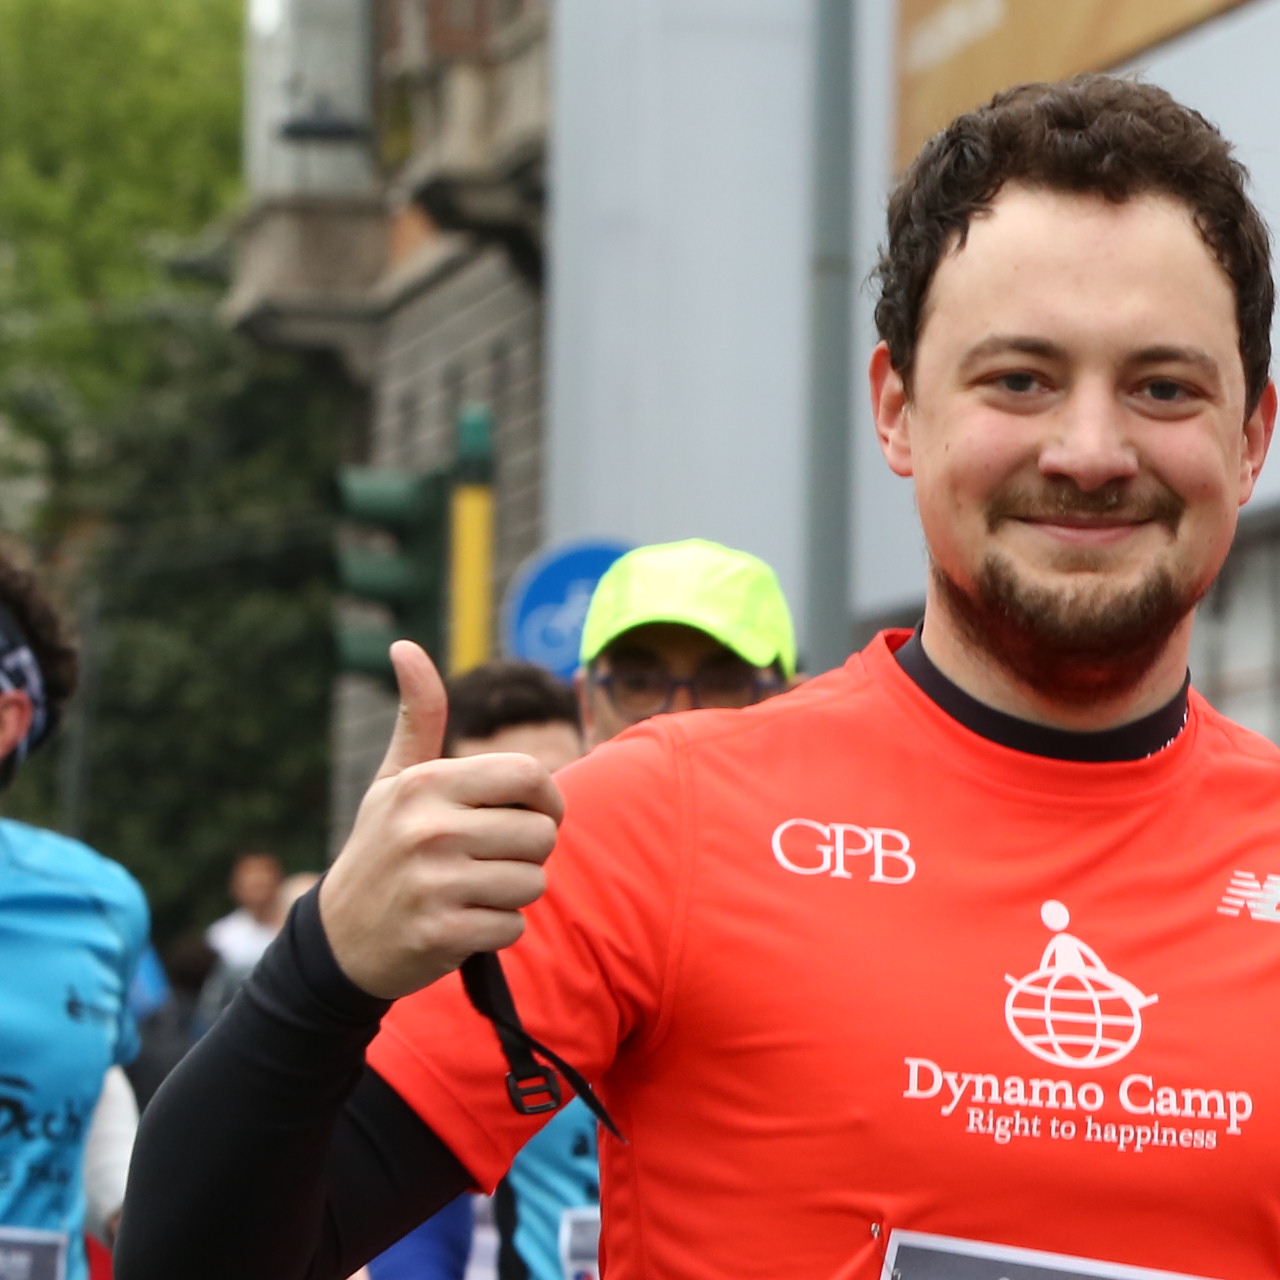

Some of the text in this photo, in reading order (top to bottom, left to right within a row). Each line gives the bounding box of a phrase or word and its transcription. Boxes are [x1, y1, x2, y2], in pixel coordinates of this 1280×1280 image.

[771, 817, 916, 884] GPB
[903, 1056, 1253, 1134] Dynamo Camp
[966, 1106, 1218, 1152] Right to happiness
